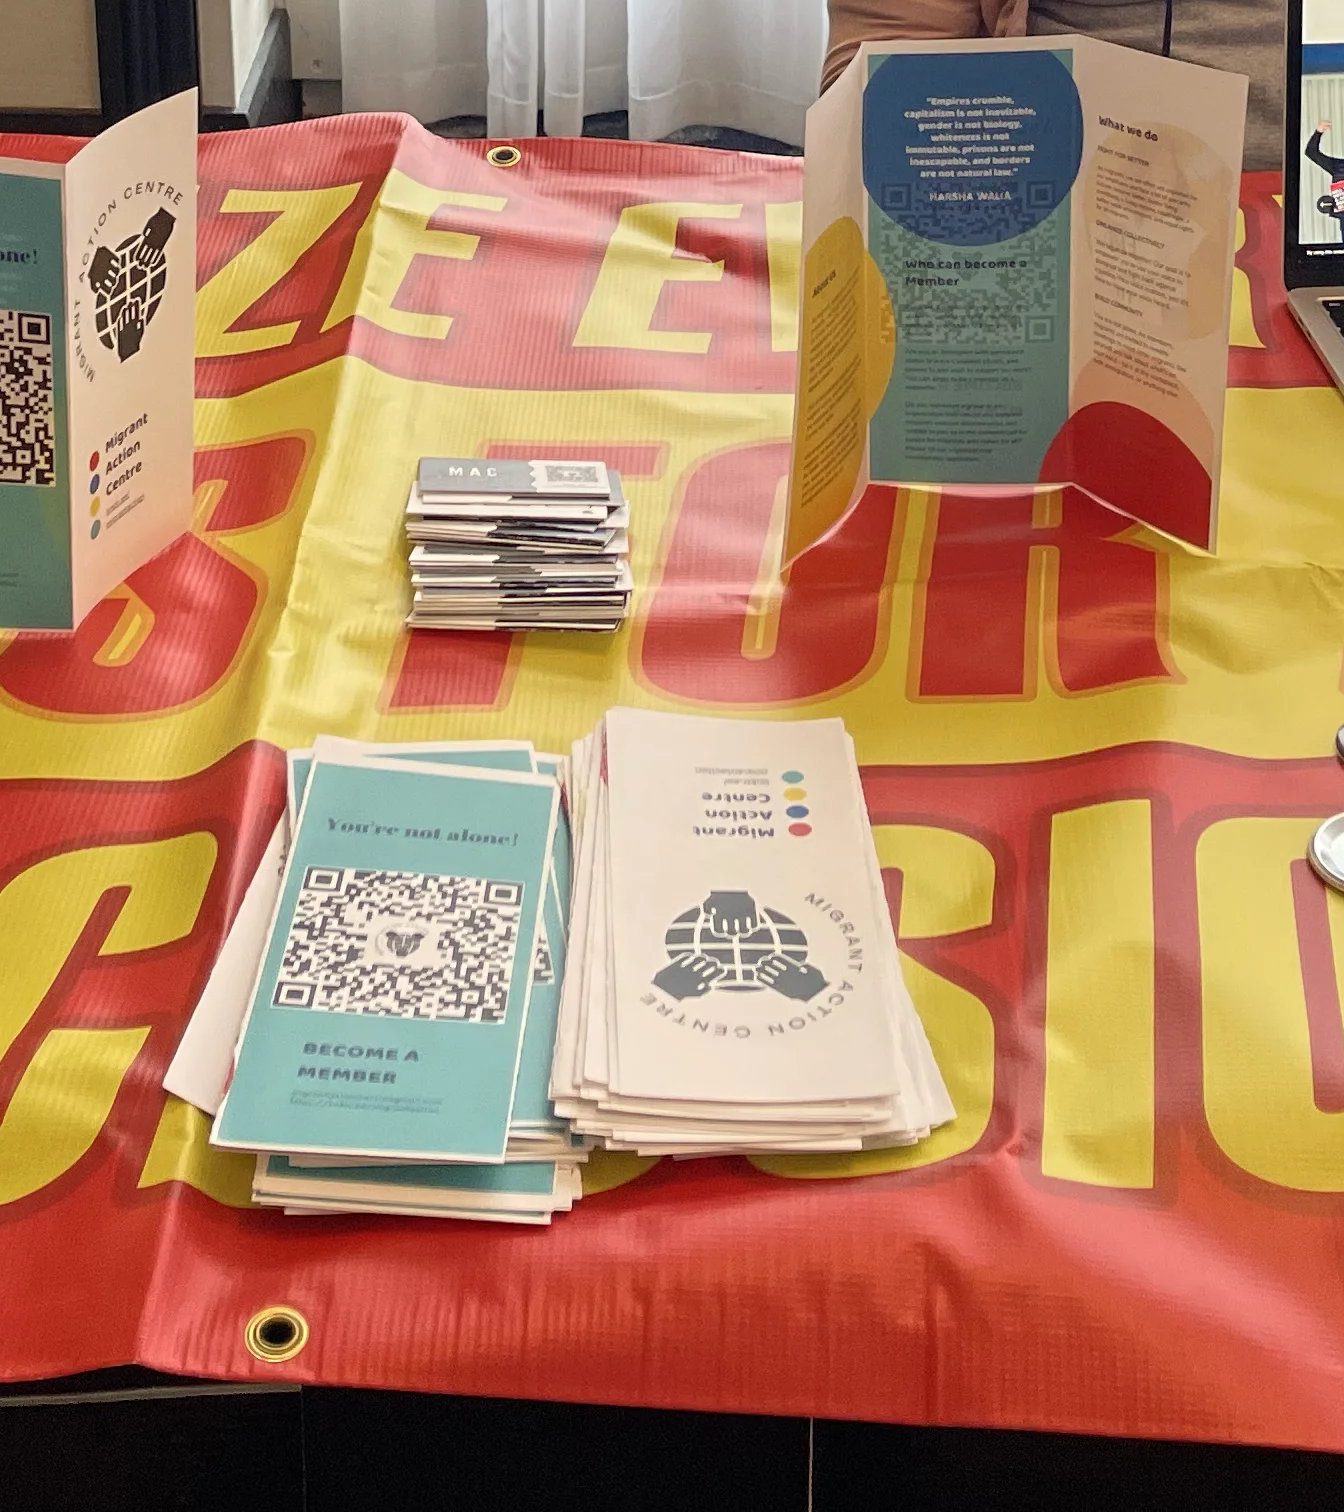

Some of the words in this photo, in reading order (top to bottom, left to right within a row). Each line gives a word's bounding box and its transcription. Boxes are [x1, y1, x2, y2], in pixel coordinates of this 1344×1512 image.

[1099, 115, 1125, 132] What
[1127, 126, 1142, 137] we
[1144, 129, 1158, 141] do
[123, 181, 183, 205] CENTRE
[938, 261, 961, 269] can
[964, 260, 1016, 269] become
[906, 277, 960, 286] Member
[105, 413, 148, 453] Migrant
[105, 441, 140, 475] Action
[106, 461, 142, 496] Centre
[448, 466, 498, 478] MAC
[702, 792, 771, 803] Centre
[705, 808, 773, 820] Action
[328, 817, 400, 835] You're
[404, 827, 441, 840] not
[447, 828, 519, 847] alone!
[692, 824, 775, 839] Migrant
[805, 892, 863, 972] MIGRANT
[640, 992, 751, 1039] CENTRE
[768, 980, 854, 1036] ACTION
[303, 1042, 398, 1060] BECOME
[404, 1050, 419, 1062] A
[297, 1066, 396, 1084] MEMBER
